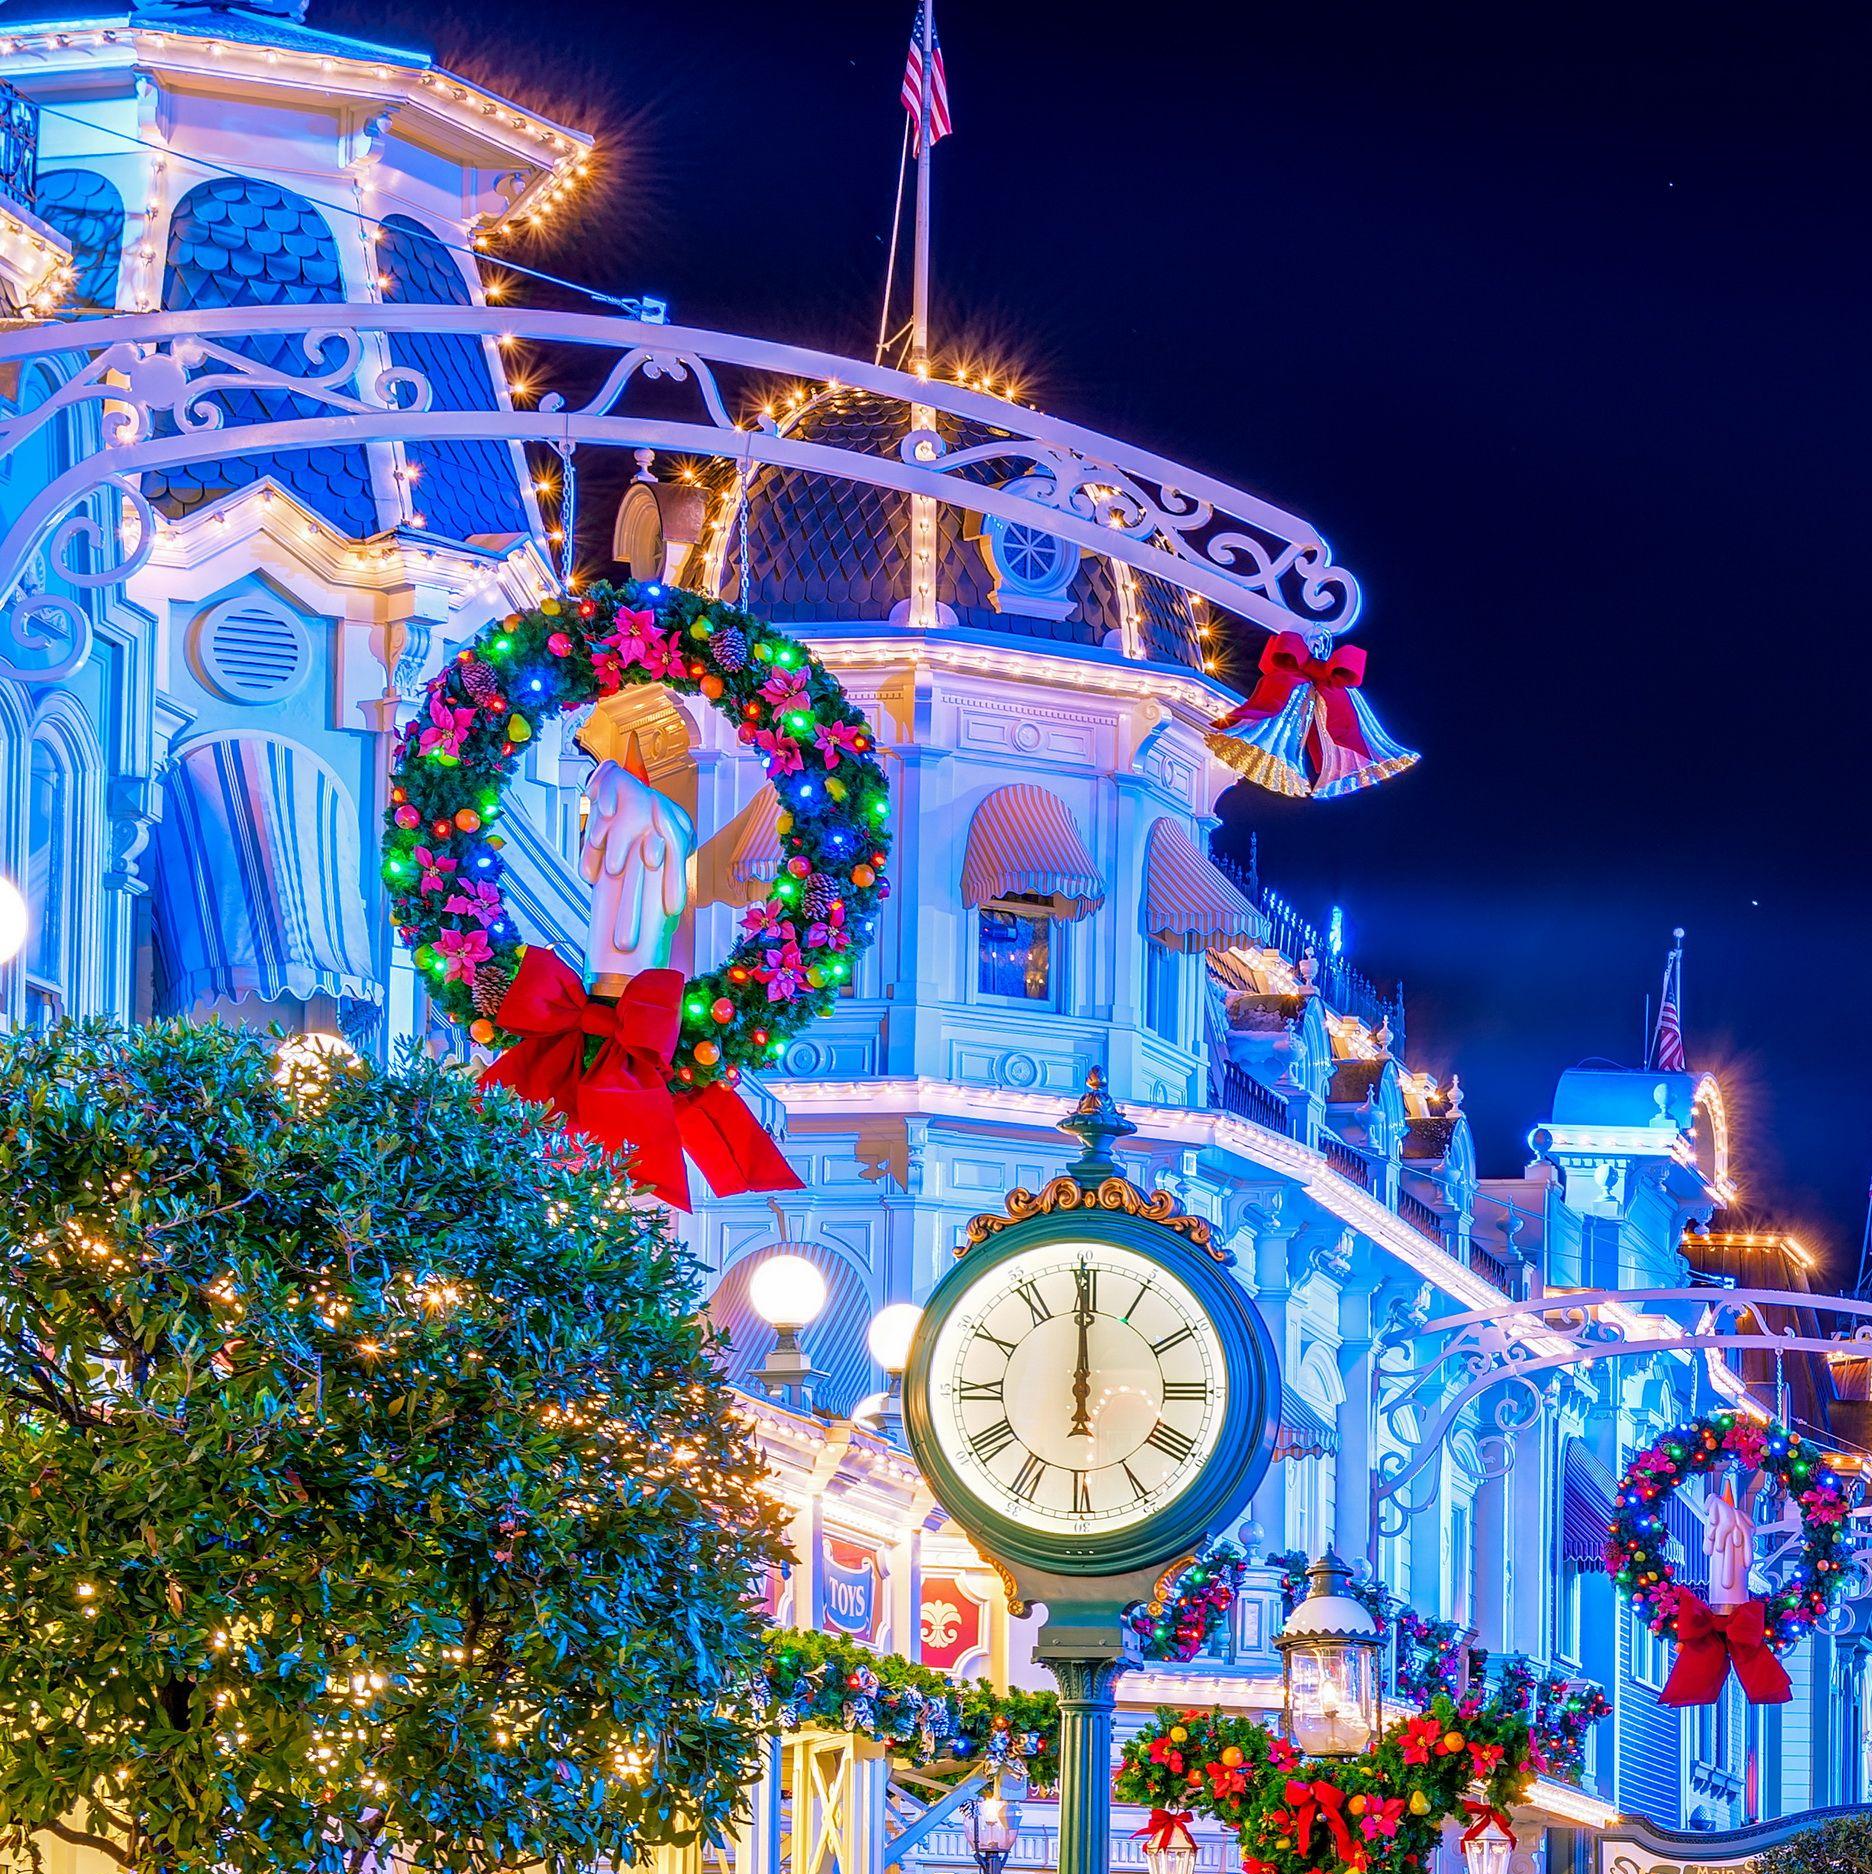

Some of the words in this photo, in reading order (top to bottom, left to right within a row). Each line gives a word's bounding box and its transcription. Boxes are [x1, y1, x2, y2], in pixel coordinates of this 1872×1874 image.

[1077, 1249, 1093, 1261] 60
[1007, 1266, 1025, 1281] 55
[1148, 1268, 1158, 1279] 5
[1012, 1278, 1054, 1327] XI
[957, 1315, 973, 1331] 50
[1196, 1317, 1210, 1332] 10
[973, 1321, 1018, 1361] X
[1150, 1323, 1196, 1359] II
[940, 1383, 951, 1398] 45
[959, 1377, 1004, 1403] IX
[1163, 1379, 1207, 1404] III
[968, 1416, 1019, 1467] VIII
[955, 1450, 971, 1466] 40
[1008, 1451, 1049, 1503] VII
[1119, 1457, 1152, 1502] V
[1068, 1469, 1095, 1513] VI
[1005, 1501, 1021, 1516] 35
[1073, 1522, 1091, 1533] 30
[829, 1576, 866, 1617] TOYS
